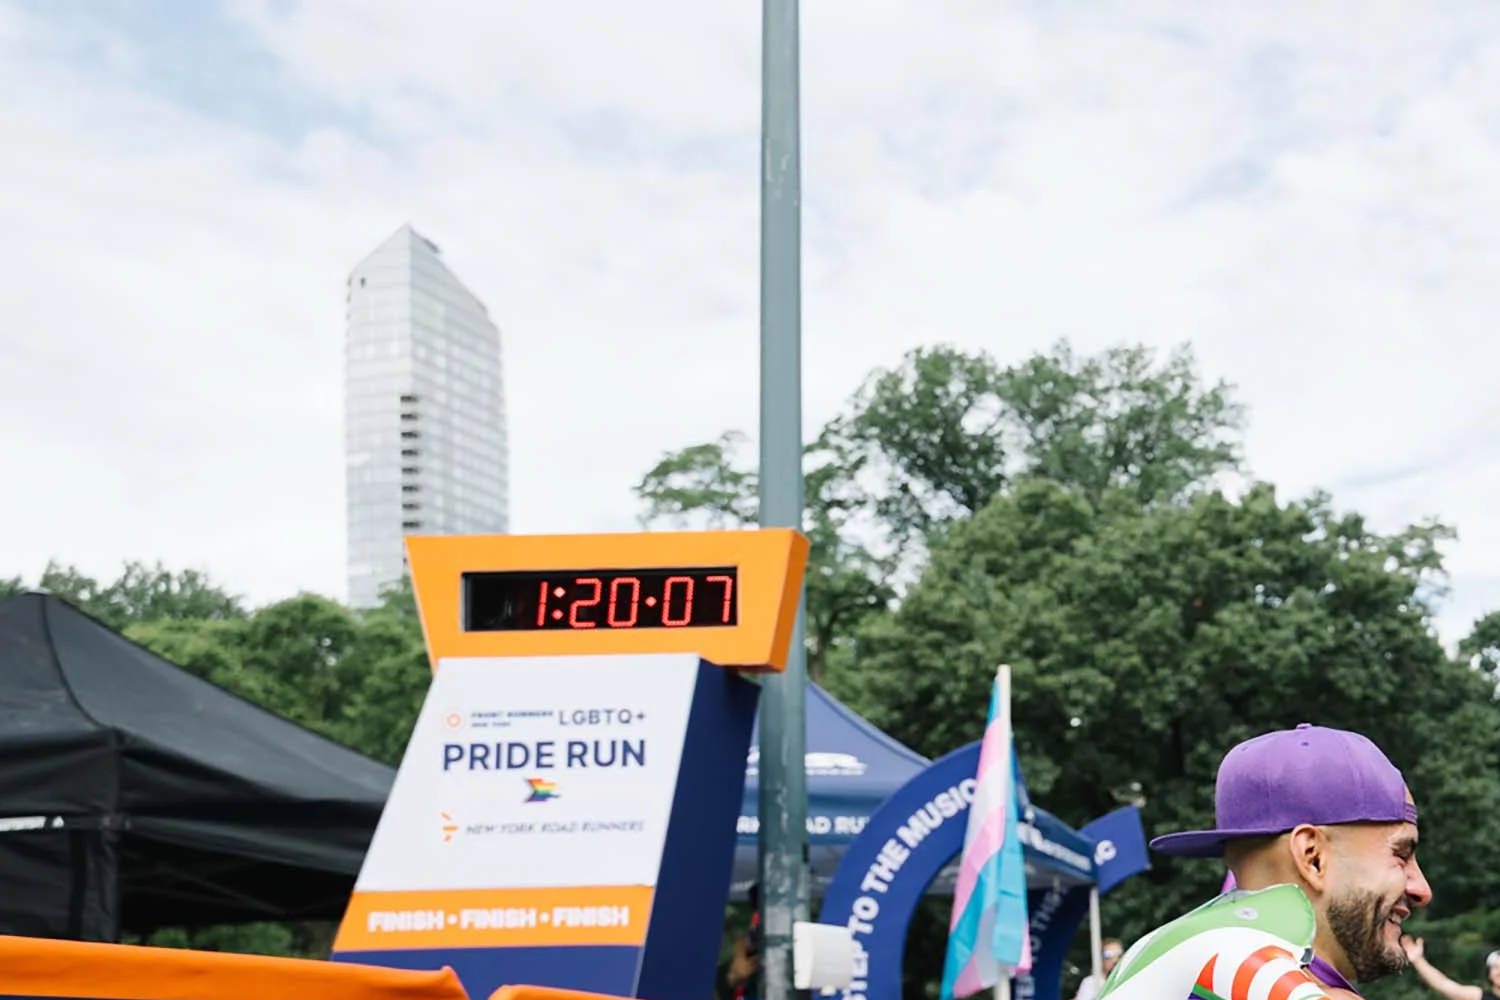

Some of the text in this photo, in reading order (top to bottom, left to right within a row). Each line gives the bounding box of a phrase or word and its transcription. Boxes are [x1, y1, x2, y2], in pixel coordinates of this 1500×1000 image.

[558, 708, 646, 726] LGBTQ+
[443, 739, 646, 772] PRIDE RUN
[860, 838, 911, 894] THE
[367, 906, 630, 932] FINISH FINISH FINISH
[847, 895, 880, 935] TO
